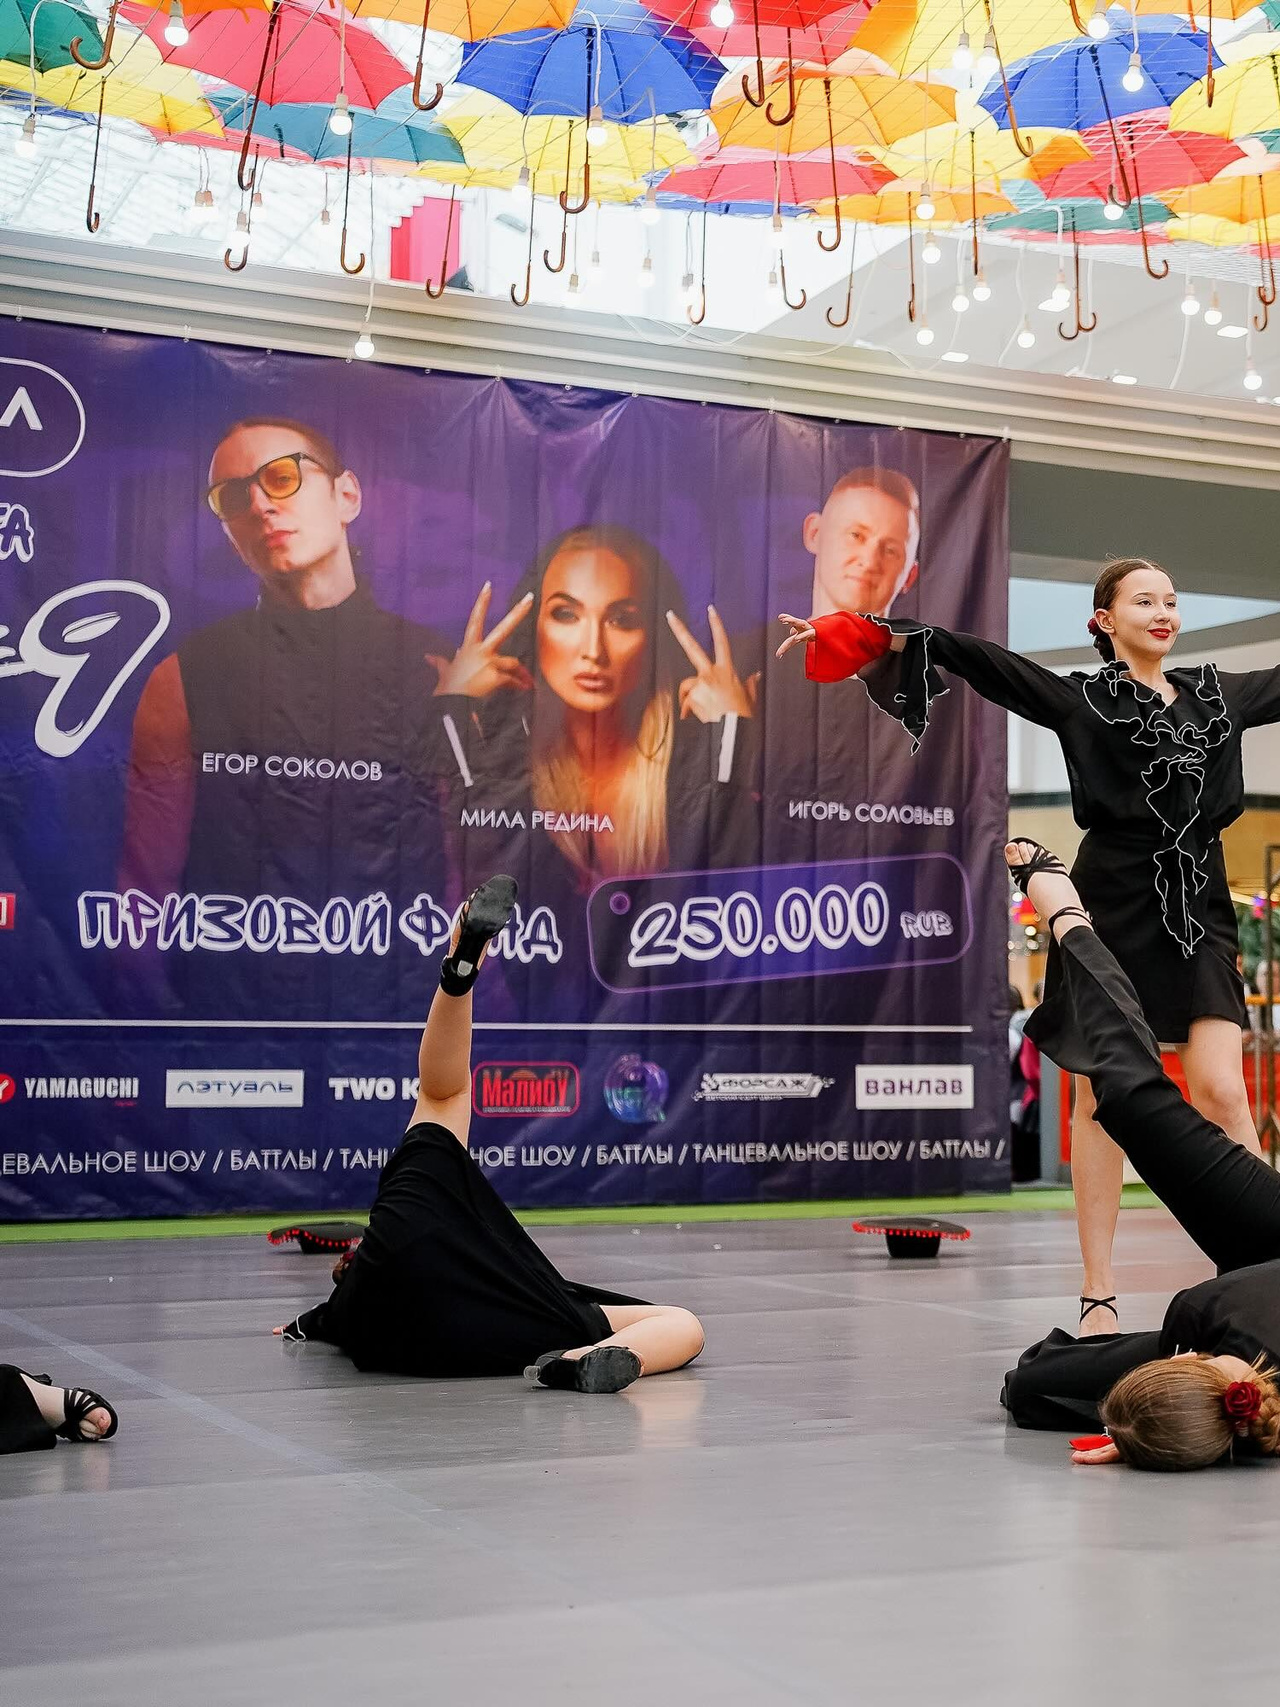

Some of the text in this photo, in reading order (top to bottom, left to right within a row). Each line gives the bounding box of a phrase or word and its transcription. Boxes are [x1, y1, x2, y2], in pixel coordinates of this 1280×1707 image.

[202, 752, 383, 781] ЕГОР СОКОЛОВ
[460, 808, 615, 833] МИЛА РЕДИНА
[788, 800, 955, 826] ИГОРЬ СОЛОВЬЕВ
[77, 888, 392, 956] ПРИЗОВОЙ
[398, 892, 563, 963] ФНД
[628, 881, 954, 968] 250.000 RUB
[24, 1077, 139, 1099] YAMAGUCHI
[329, 1077, 396, 1100] TWO
[0, 1150, 137, 1175] ЕВАЛЬНОЕ
[144, 1150, 206, 1172] ШОУ
[230, 1149, 317, 1172] БАТТЛЫ
[521, 1144, 577, 1168] ШОУ
[597, 1143, 673, 1166] БАТТЛЫ
[692, 1140, 850, 1165] ТАНЦЕВАЛЬНОЕ
[853, 1140, 903, 1162] ШОУ
[919, 1138, 991, 1161] БАТТЛЫ
